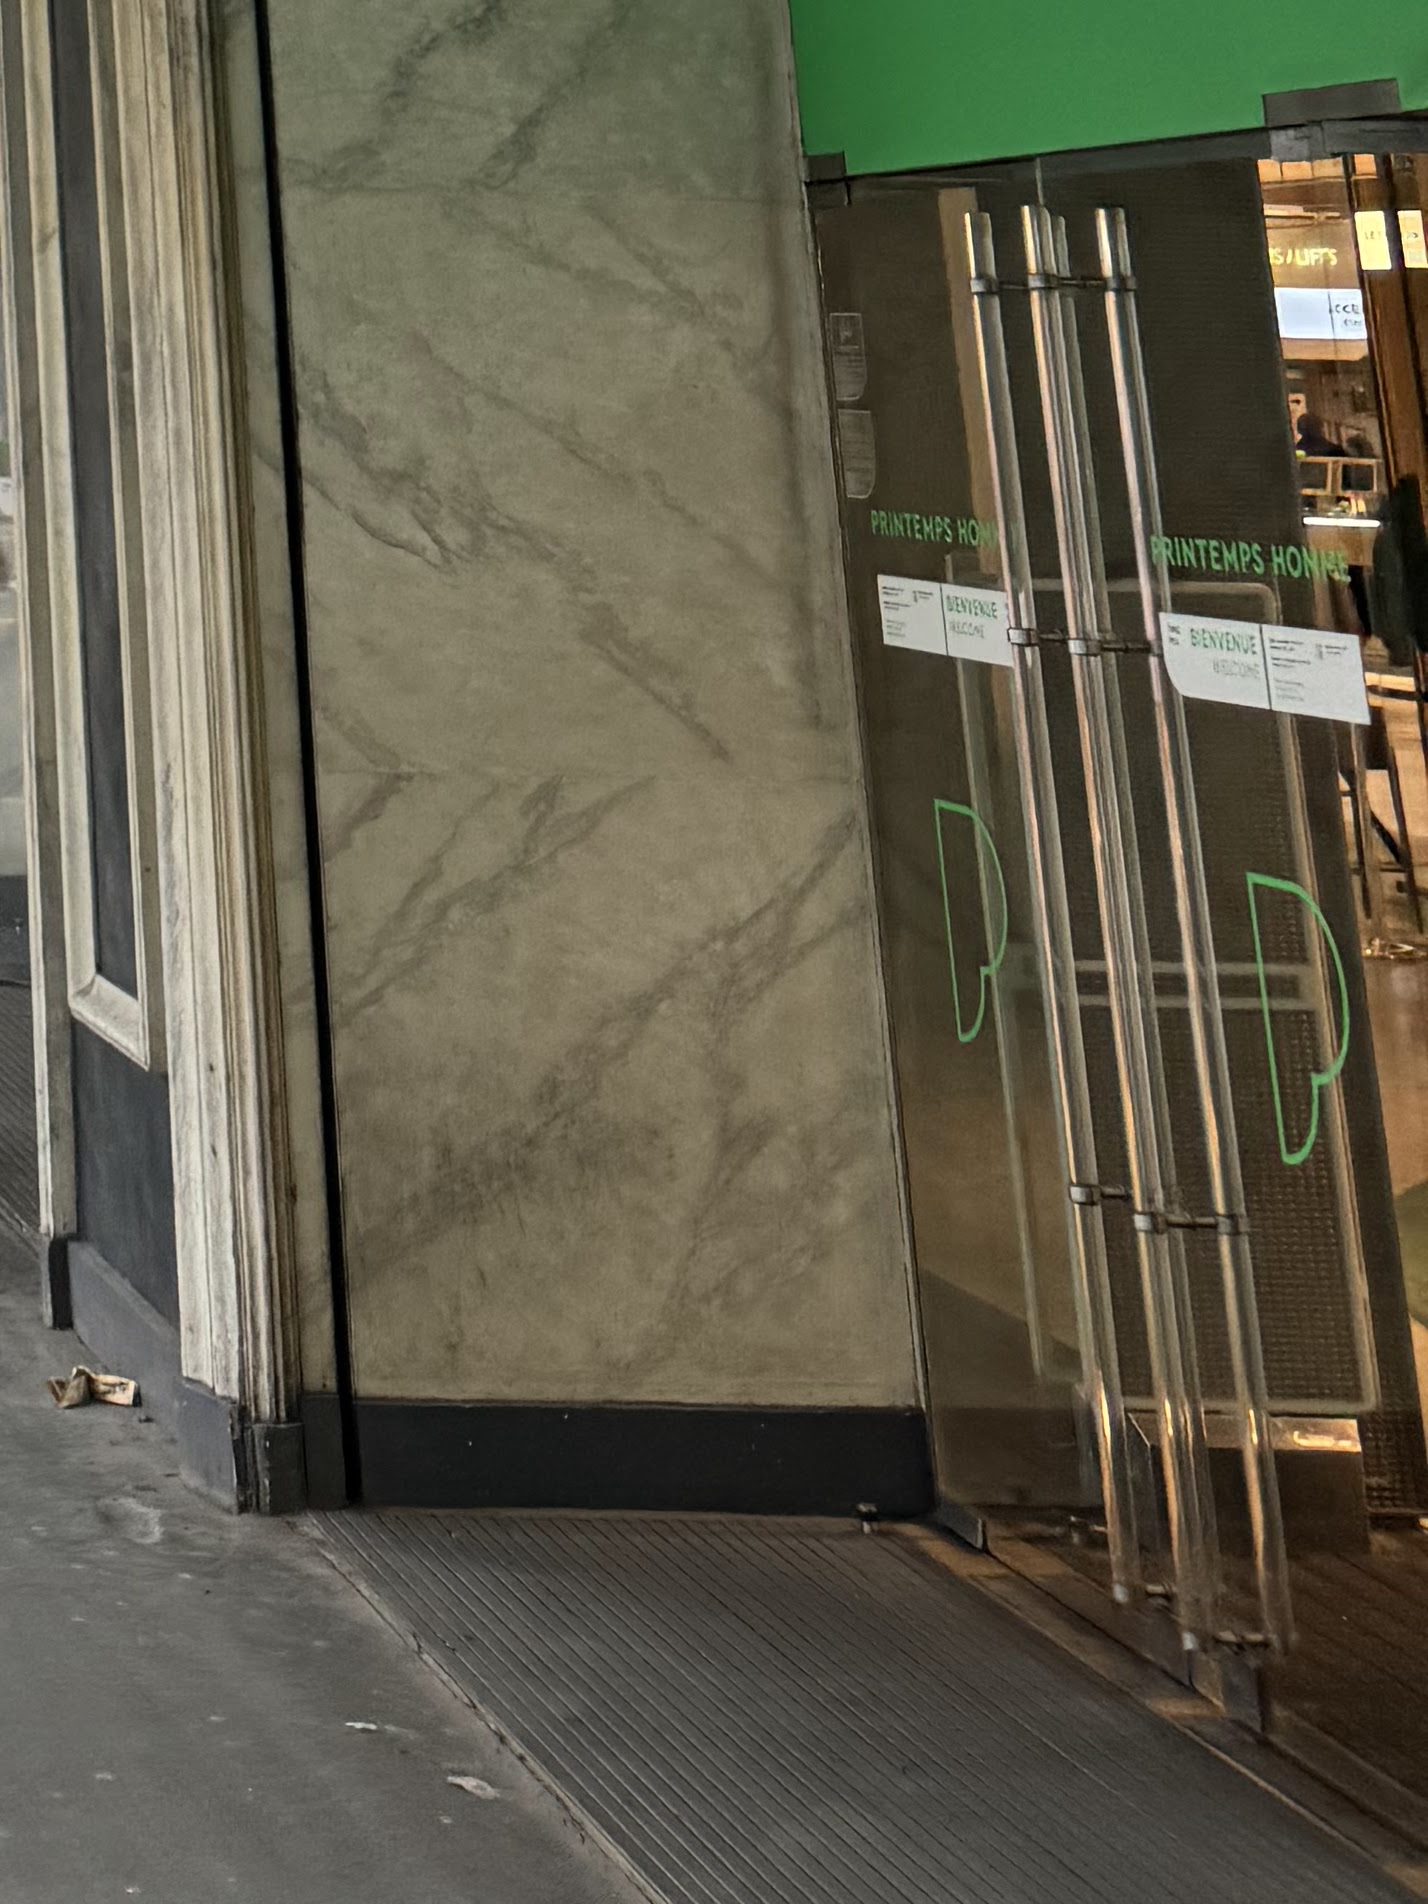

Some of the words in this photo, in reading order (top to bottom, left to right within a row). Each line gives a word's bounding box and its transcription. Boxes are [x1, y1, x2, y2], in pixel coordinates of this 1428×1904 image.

[871, 510, 953, 543] PRINTEMPS
[1150, 535, 1265, 576] PRINTEMPS
[1189, 627, 1259, 656] BIENVENUE
